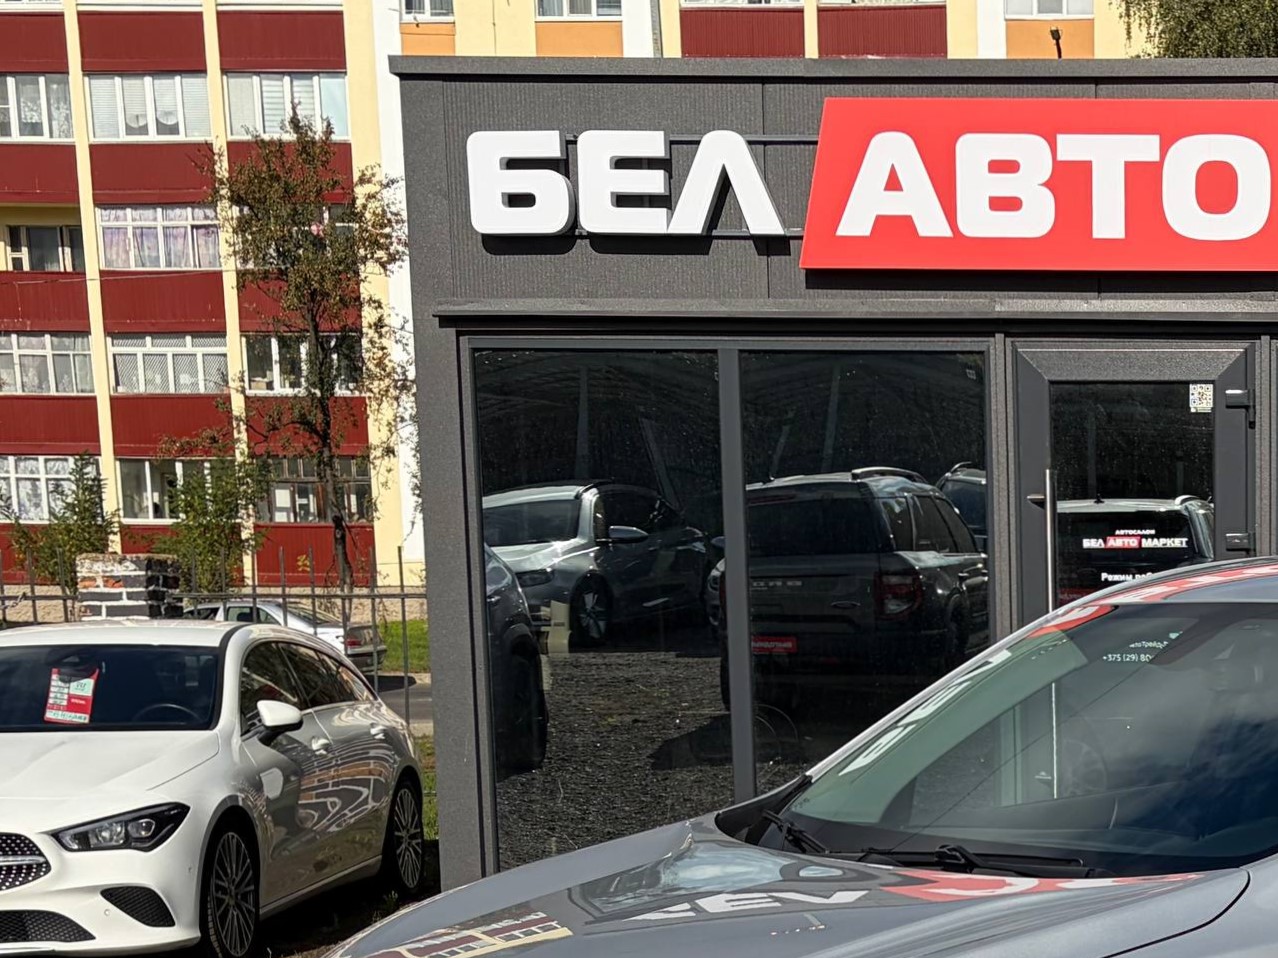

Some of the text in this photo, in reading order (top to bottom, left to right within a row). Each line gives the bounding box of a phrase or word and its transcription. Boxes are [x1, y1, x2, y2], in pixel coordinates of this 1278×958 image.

[466, 129, 785, 235] БЕЛ
[835, 131, 1272, 240] АВТО
[1082, 537, 1189, 549] БЕЛ АВТО МАРКЕТ
[1122, 653, 1139, 662] (29)
